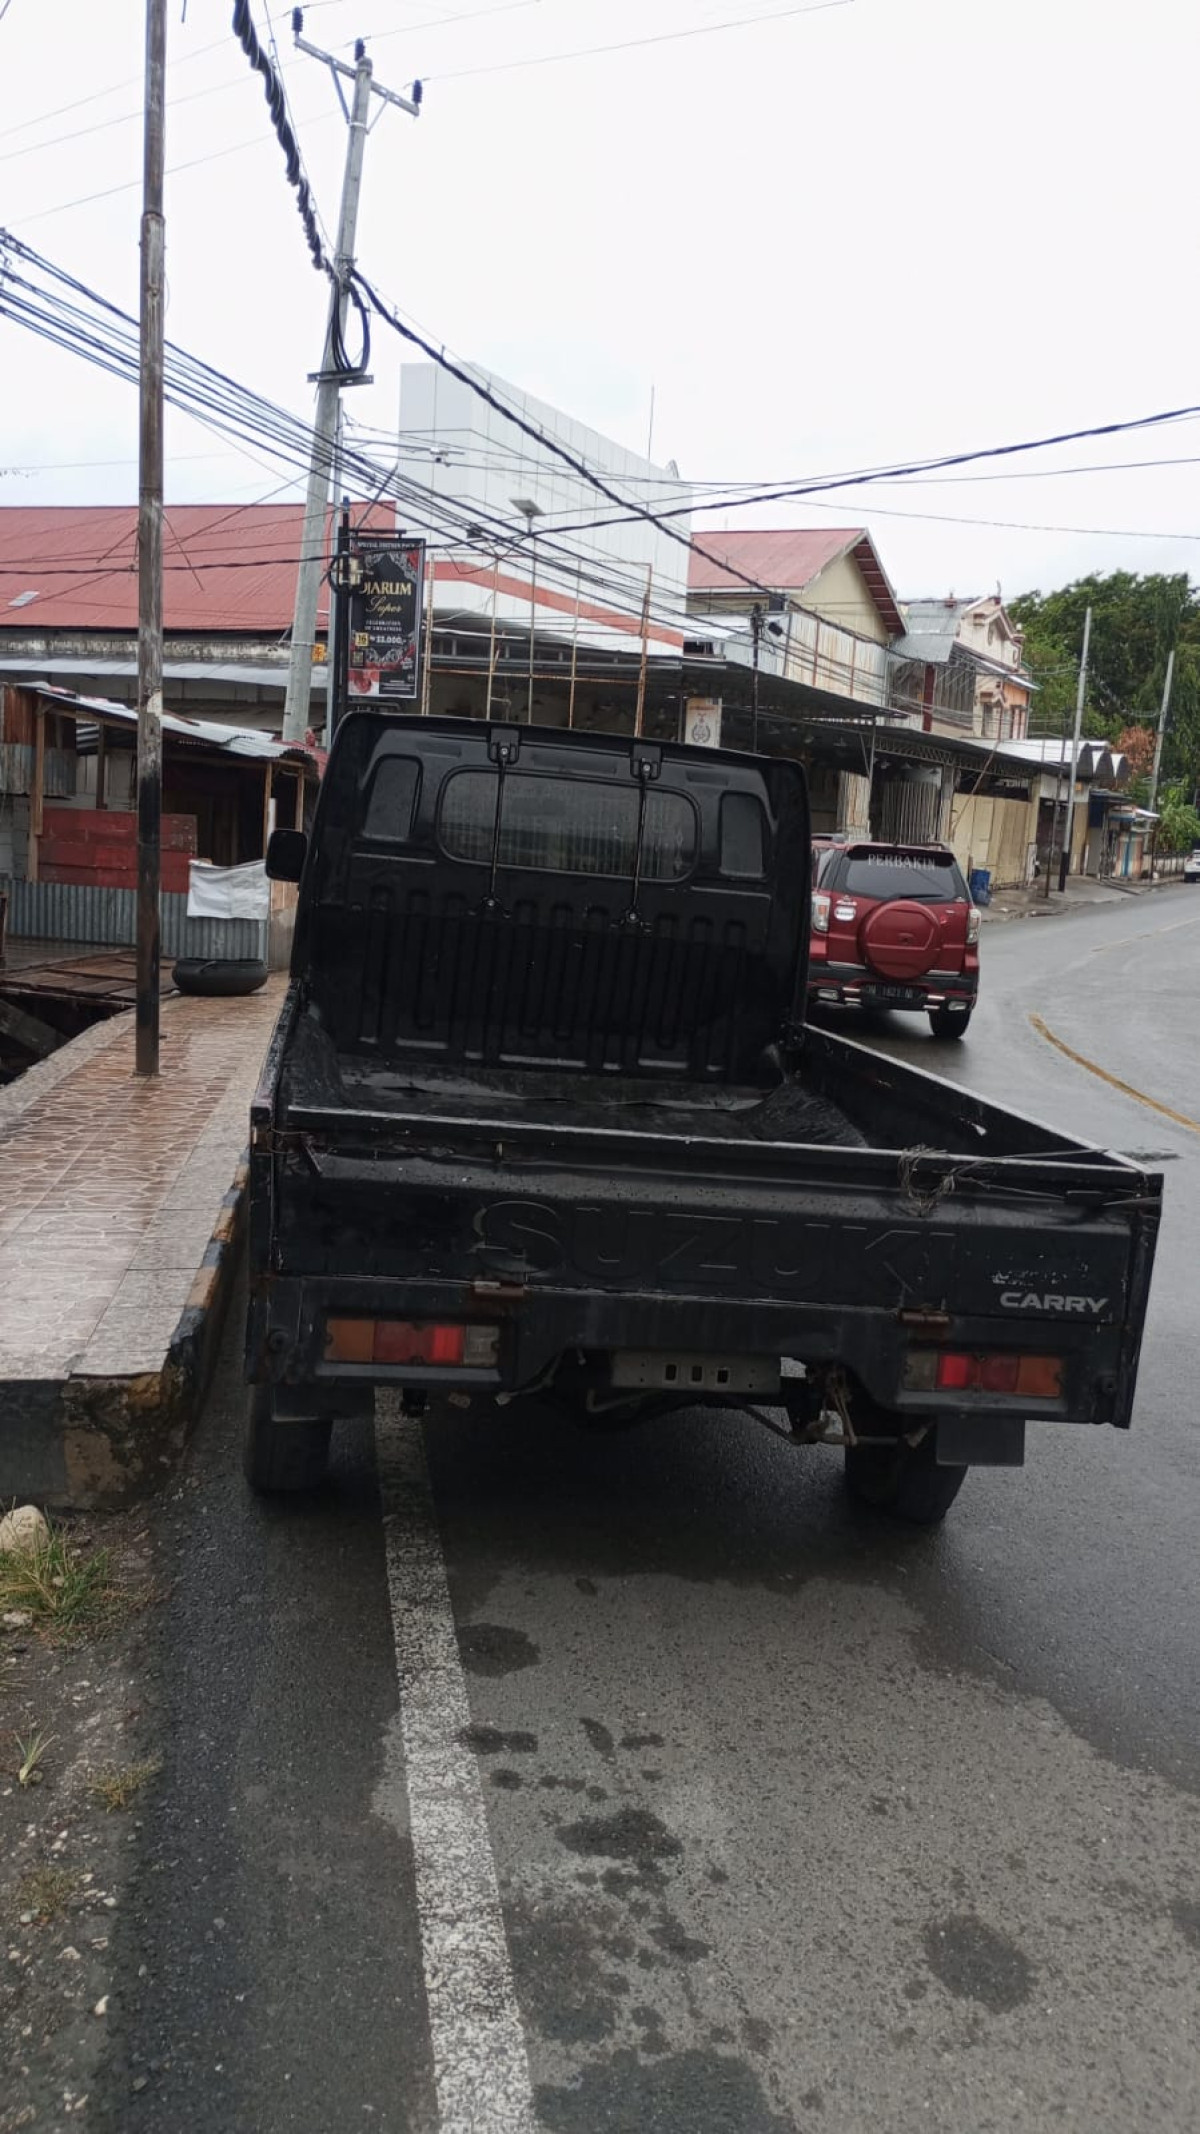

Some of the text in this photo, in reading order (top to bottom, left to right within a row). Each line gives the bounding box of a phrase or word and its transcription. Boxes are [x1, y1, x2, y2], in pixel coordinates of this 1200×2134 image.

[365, 595, 402, 618] Super
[868, 853, 935, 870] PERBAKIN
[472, 1201, 958, 1299] SUZUKI
[998, 1290, 1109, 1314] CARRY
